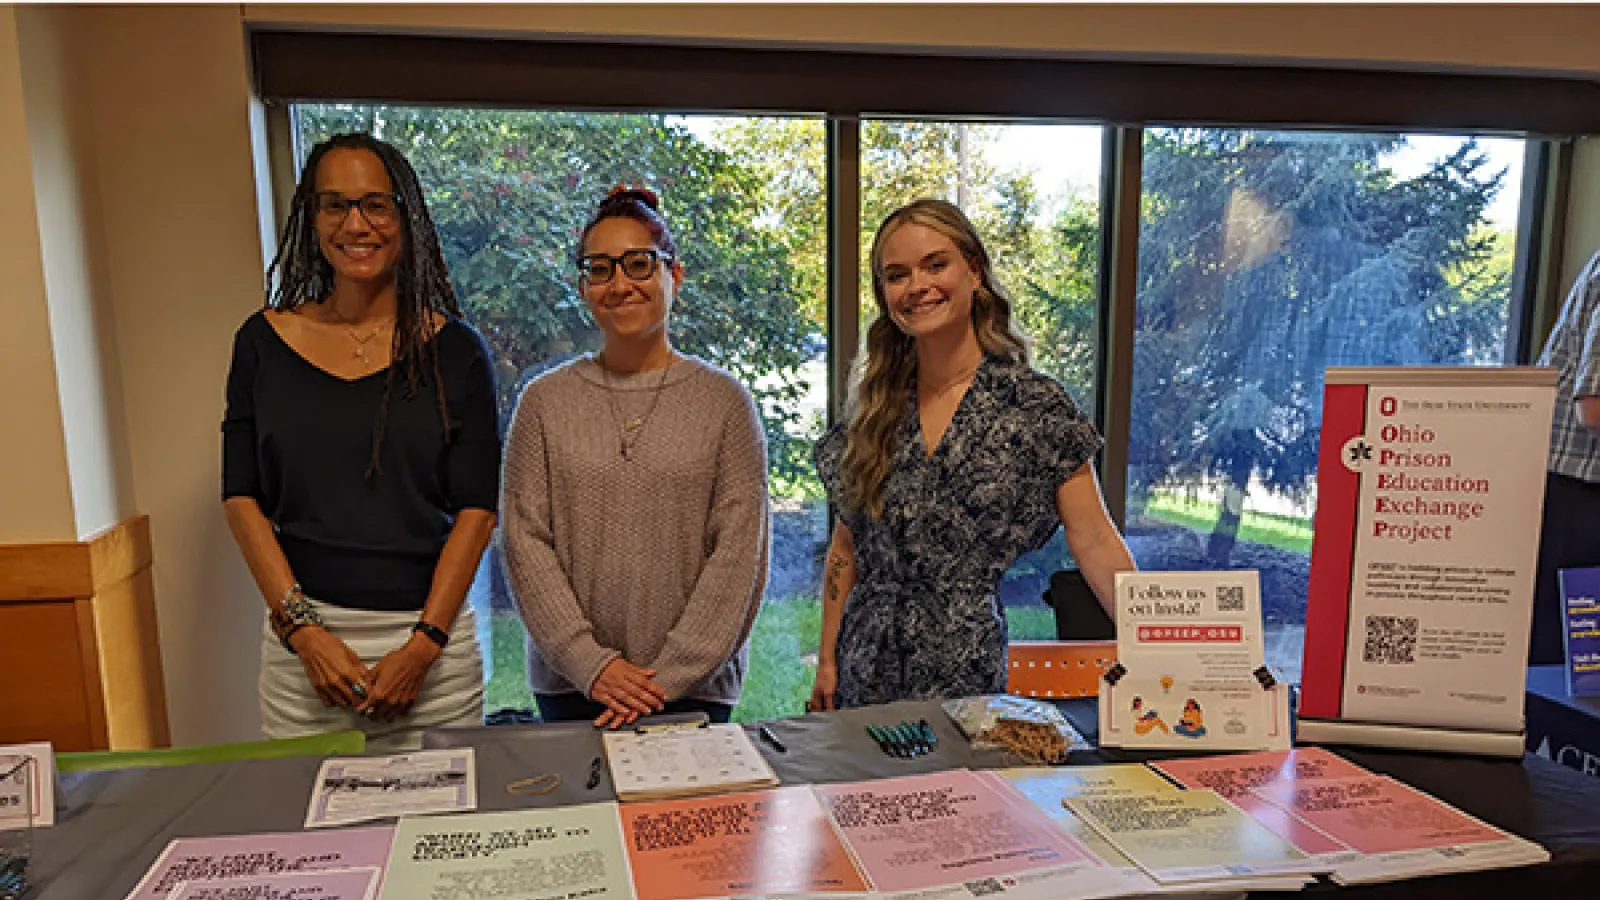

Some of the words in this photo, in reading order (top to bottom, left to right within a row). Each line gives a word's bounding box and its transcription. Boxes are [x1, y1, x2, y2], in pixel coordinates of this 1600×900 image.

[1381, 424, 1435, 443] Ohio
[1380, 448, 1451, 467] Prison
[1378, 472, 1488, 493] Education
[1375, 496, 1484, 521] Exchange
[1373, 520, 1452, 544] Project
[1128, 584, 1182, 600] Follow
[1186, 589, 1206, 599] us
[1128, 604, 1152, 615] on
